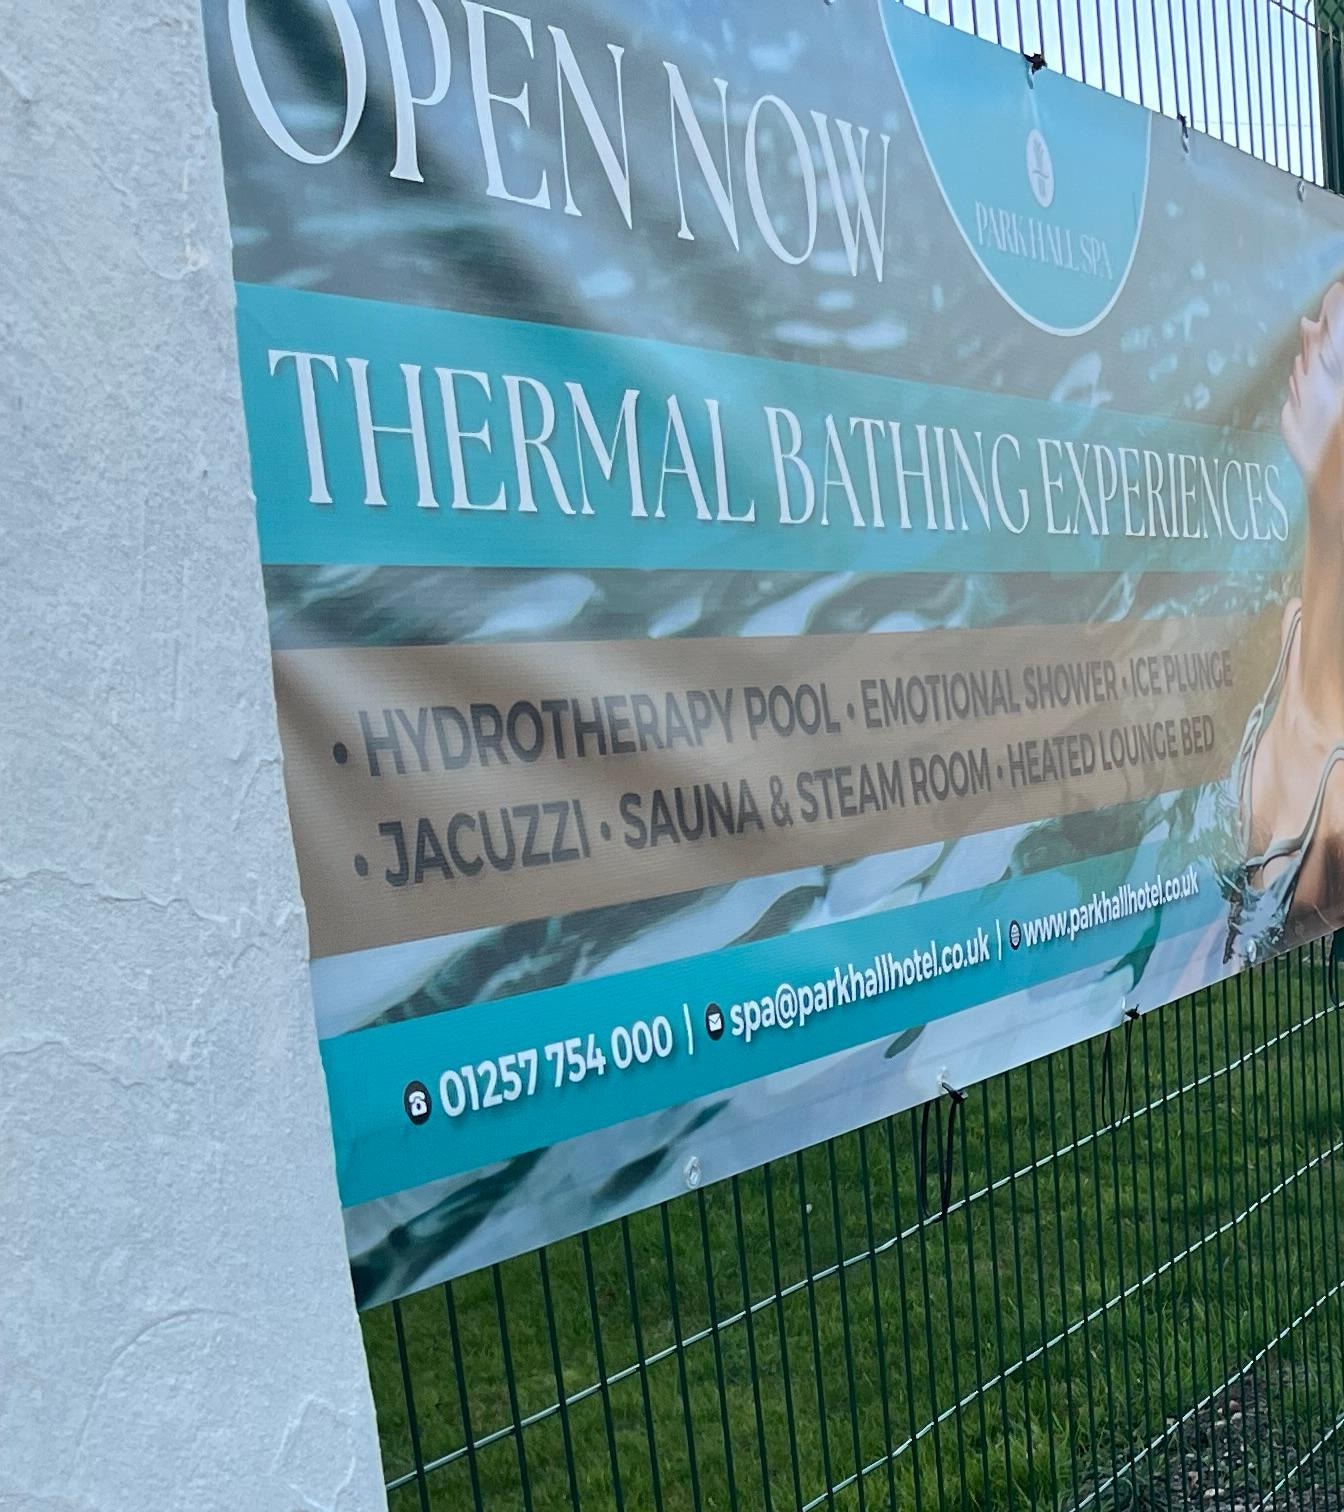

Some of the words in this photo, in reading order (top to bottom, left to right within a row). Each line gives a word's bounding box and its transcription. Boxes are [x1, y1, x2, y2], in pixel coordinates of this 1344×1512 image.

[228, 0, 632, 229] OPEN
[662, 60, 890, 282] NOW
[975, 200, 1028, 256] PARK
[1029, 217, 1080, 272] HALL
[1081, 233, 1113, 280] SPA
[268, 350, 755, 521] THERMAL
[764, 406, 1030, 534] BATHING
[1038, 437, 1290, 542] EXPERIENCES
[359, 688, 734, 777] HYDROTHERAPY
[744, 682, 841, 741] POOL
[860, 669, 1021, 729] EMOTIONAL
[1022, 660, 1119, 710] SHOWER
[1129, 656, 1162, 698] ICE
[1164, 650, 1234, 693] PLUNGE
[378, 800, 591, 887] JACUZZI
[619, 779, 765, 850] SAUNA
[769, 774, 794, 828] &
[796, 759, 906, 823] STEAM
[908, 747, 992, 806] ROOM
[1006, 734, 1096, 788] HEATED
[1098, 720, 1178, 772] LOUNGE
[1181, 715, 1215, 756] BED
[439, 1049, 538, 1117] 01257
[544, 1034, 606, 1088] 754
[611, 1015, 673, 1069] 000
[730, 927, 991, 1043] spa@parkhallhotel.co.uk
[1022, 865, 1200, 947] www.parkhallhotel.co.uk
